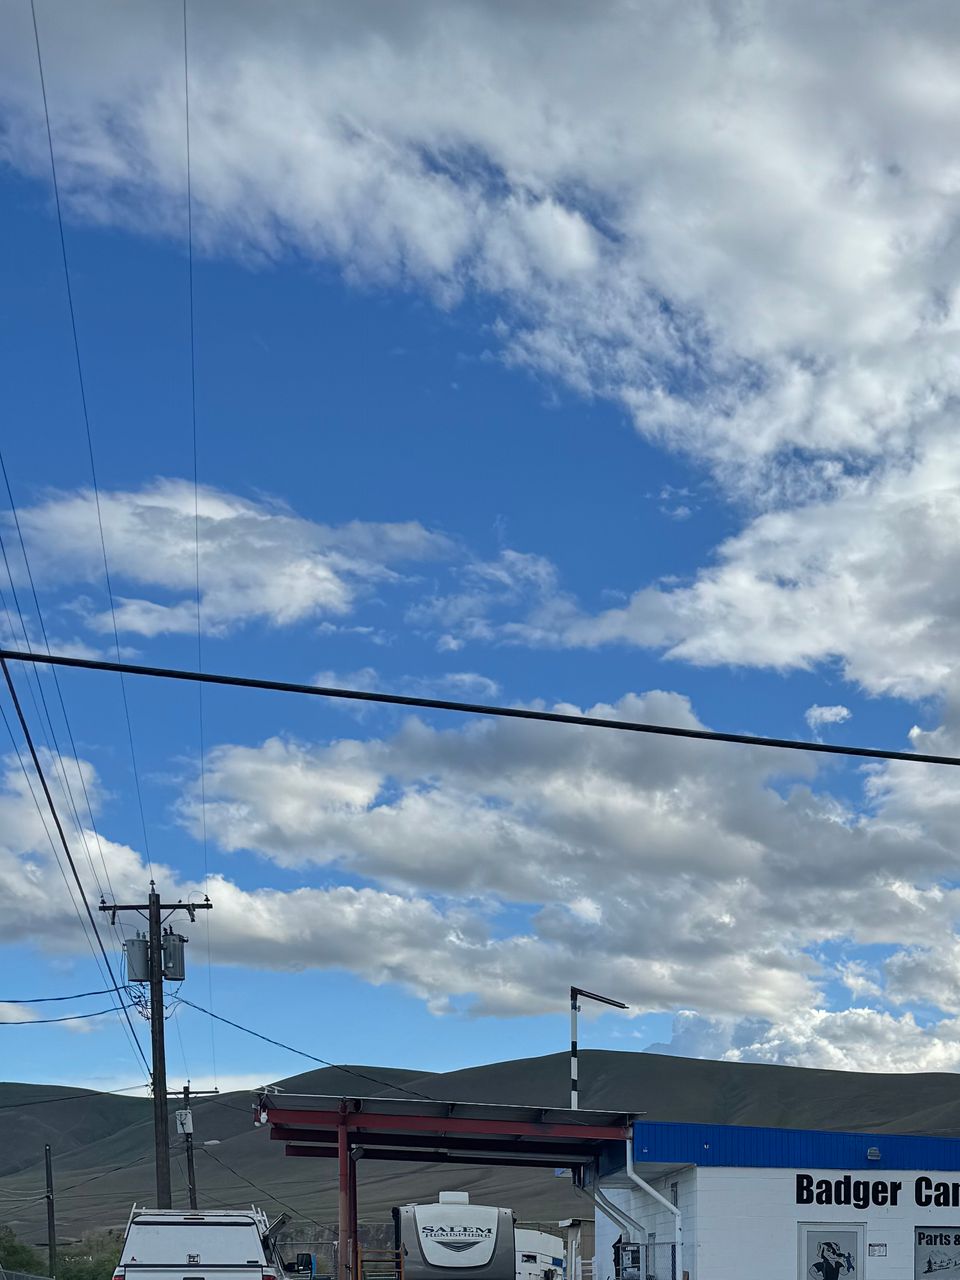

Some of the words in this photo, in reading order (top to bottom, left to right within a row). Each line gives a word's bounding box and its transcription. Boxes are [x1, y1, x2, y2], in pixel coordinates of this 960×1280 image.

[796, 1174, 902, 1209] Badger
[422, 1226, 493, 1234] SALEM
[918, 1231, 951, 1246] Parts
